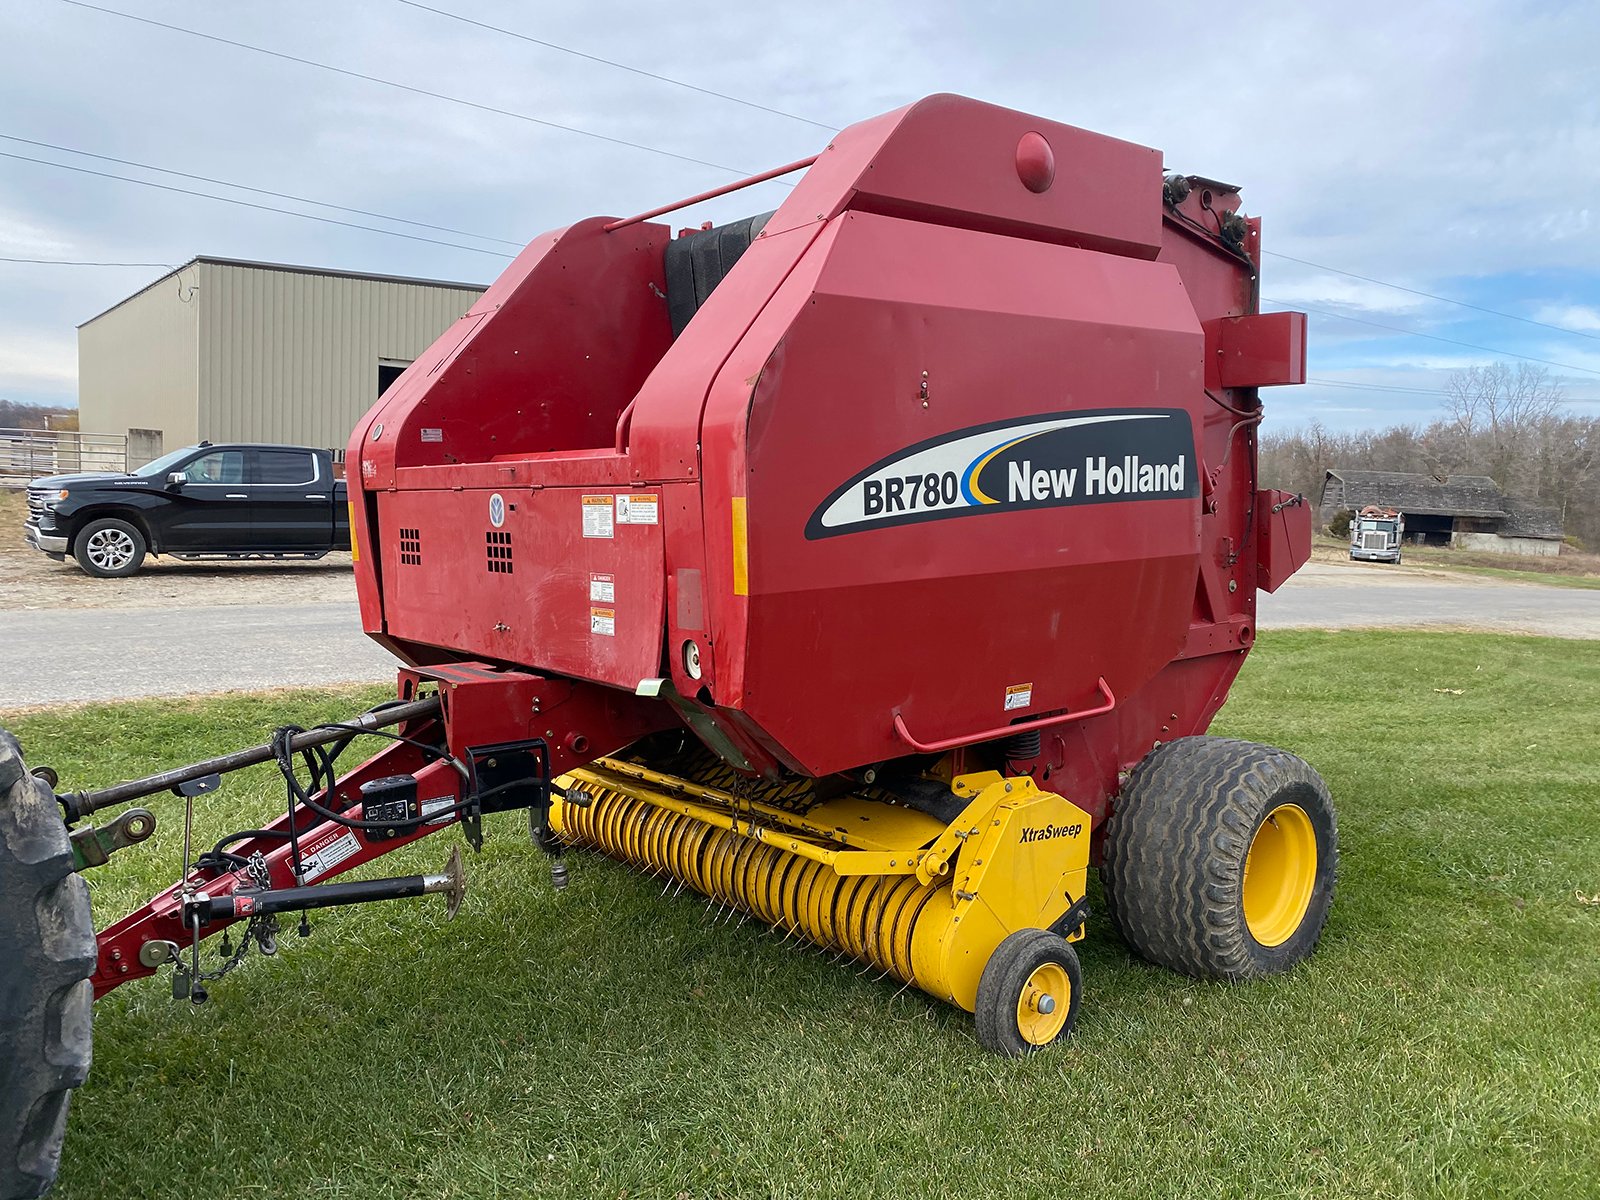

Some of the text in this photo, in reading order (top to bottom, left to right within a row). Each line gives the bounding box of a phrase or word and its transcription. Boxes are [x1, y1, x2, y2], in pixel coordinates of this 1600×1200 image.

[863, 455, 1185, 516] BR780 New Holland
[310, 833, 339, 853] DANGER
[1019, 824, 1082, 844] XtraSweep
